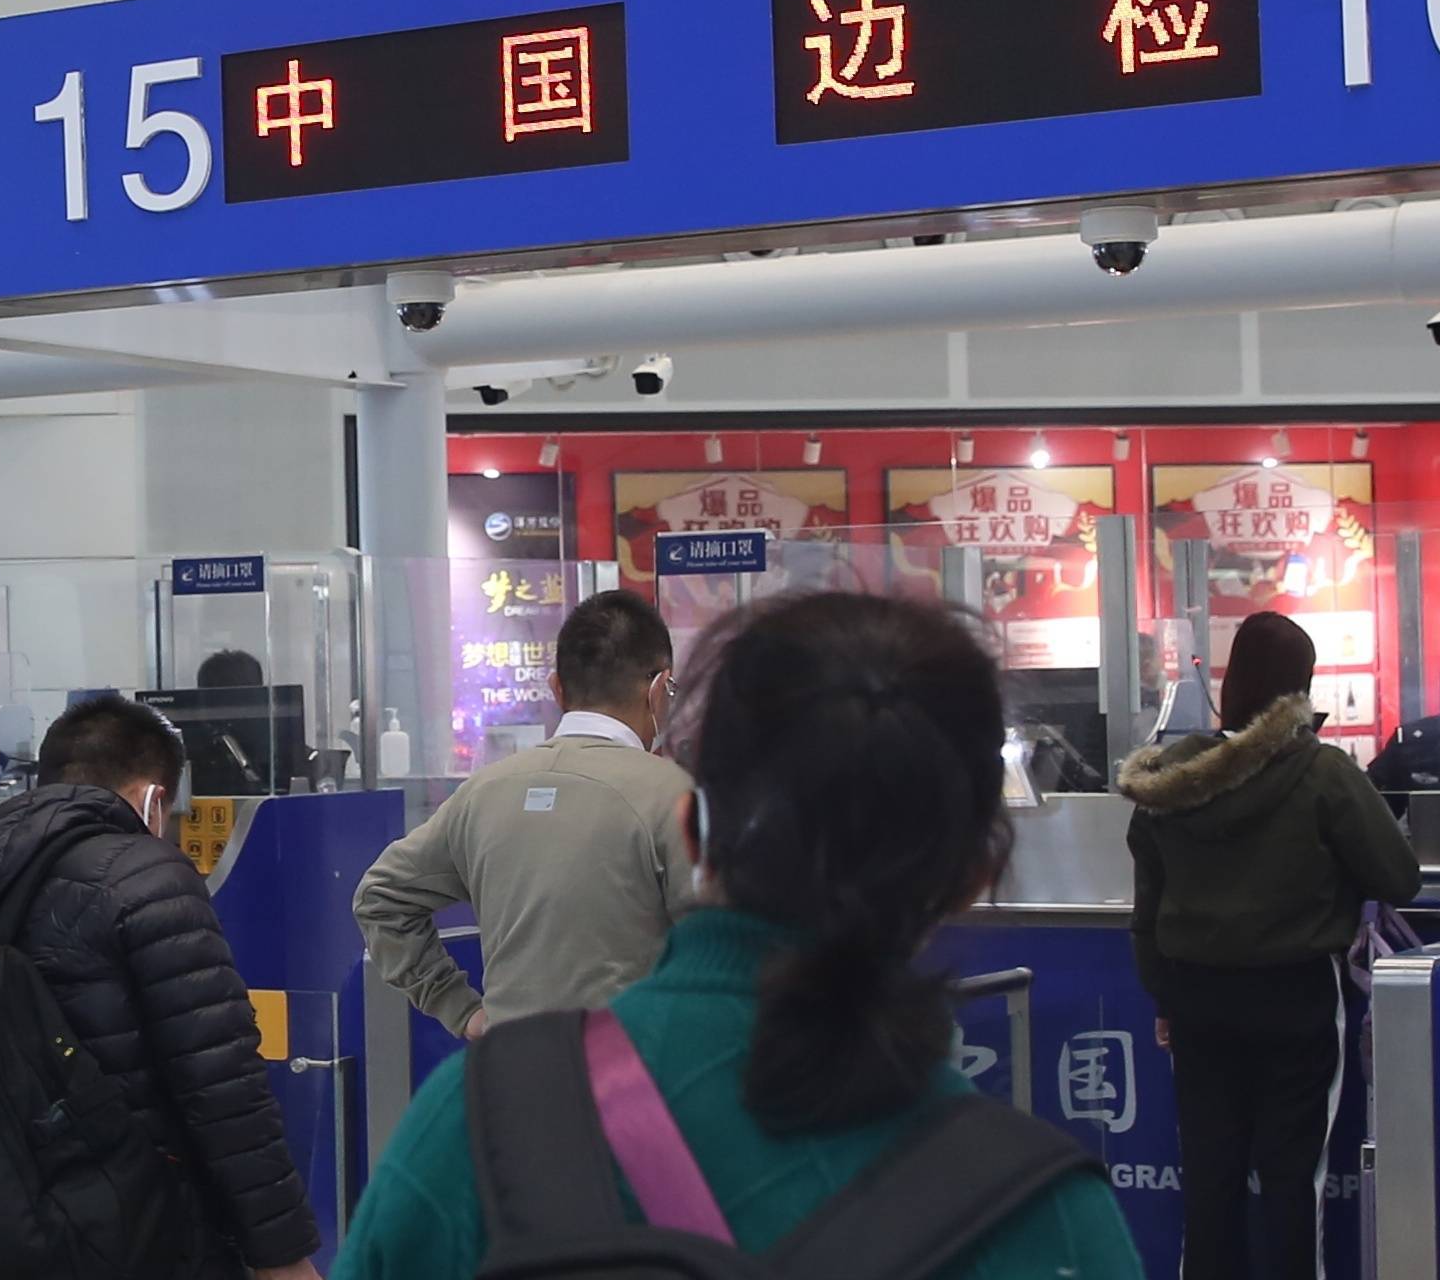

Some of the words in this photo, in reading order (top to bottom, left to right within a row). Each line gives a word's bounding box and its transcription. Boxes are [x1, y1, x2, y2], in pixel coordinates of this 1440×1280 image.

[34, 57, 212, 221] 15
[255, 25, 592, 167] 中国
[690, 539, 753, 558] 请摘口罩
